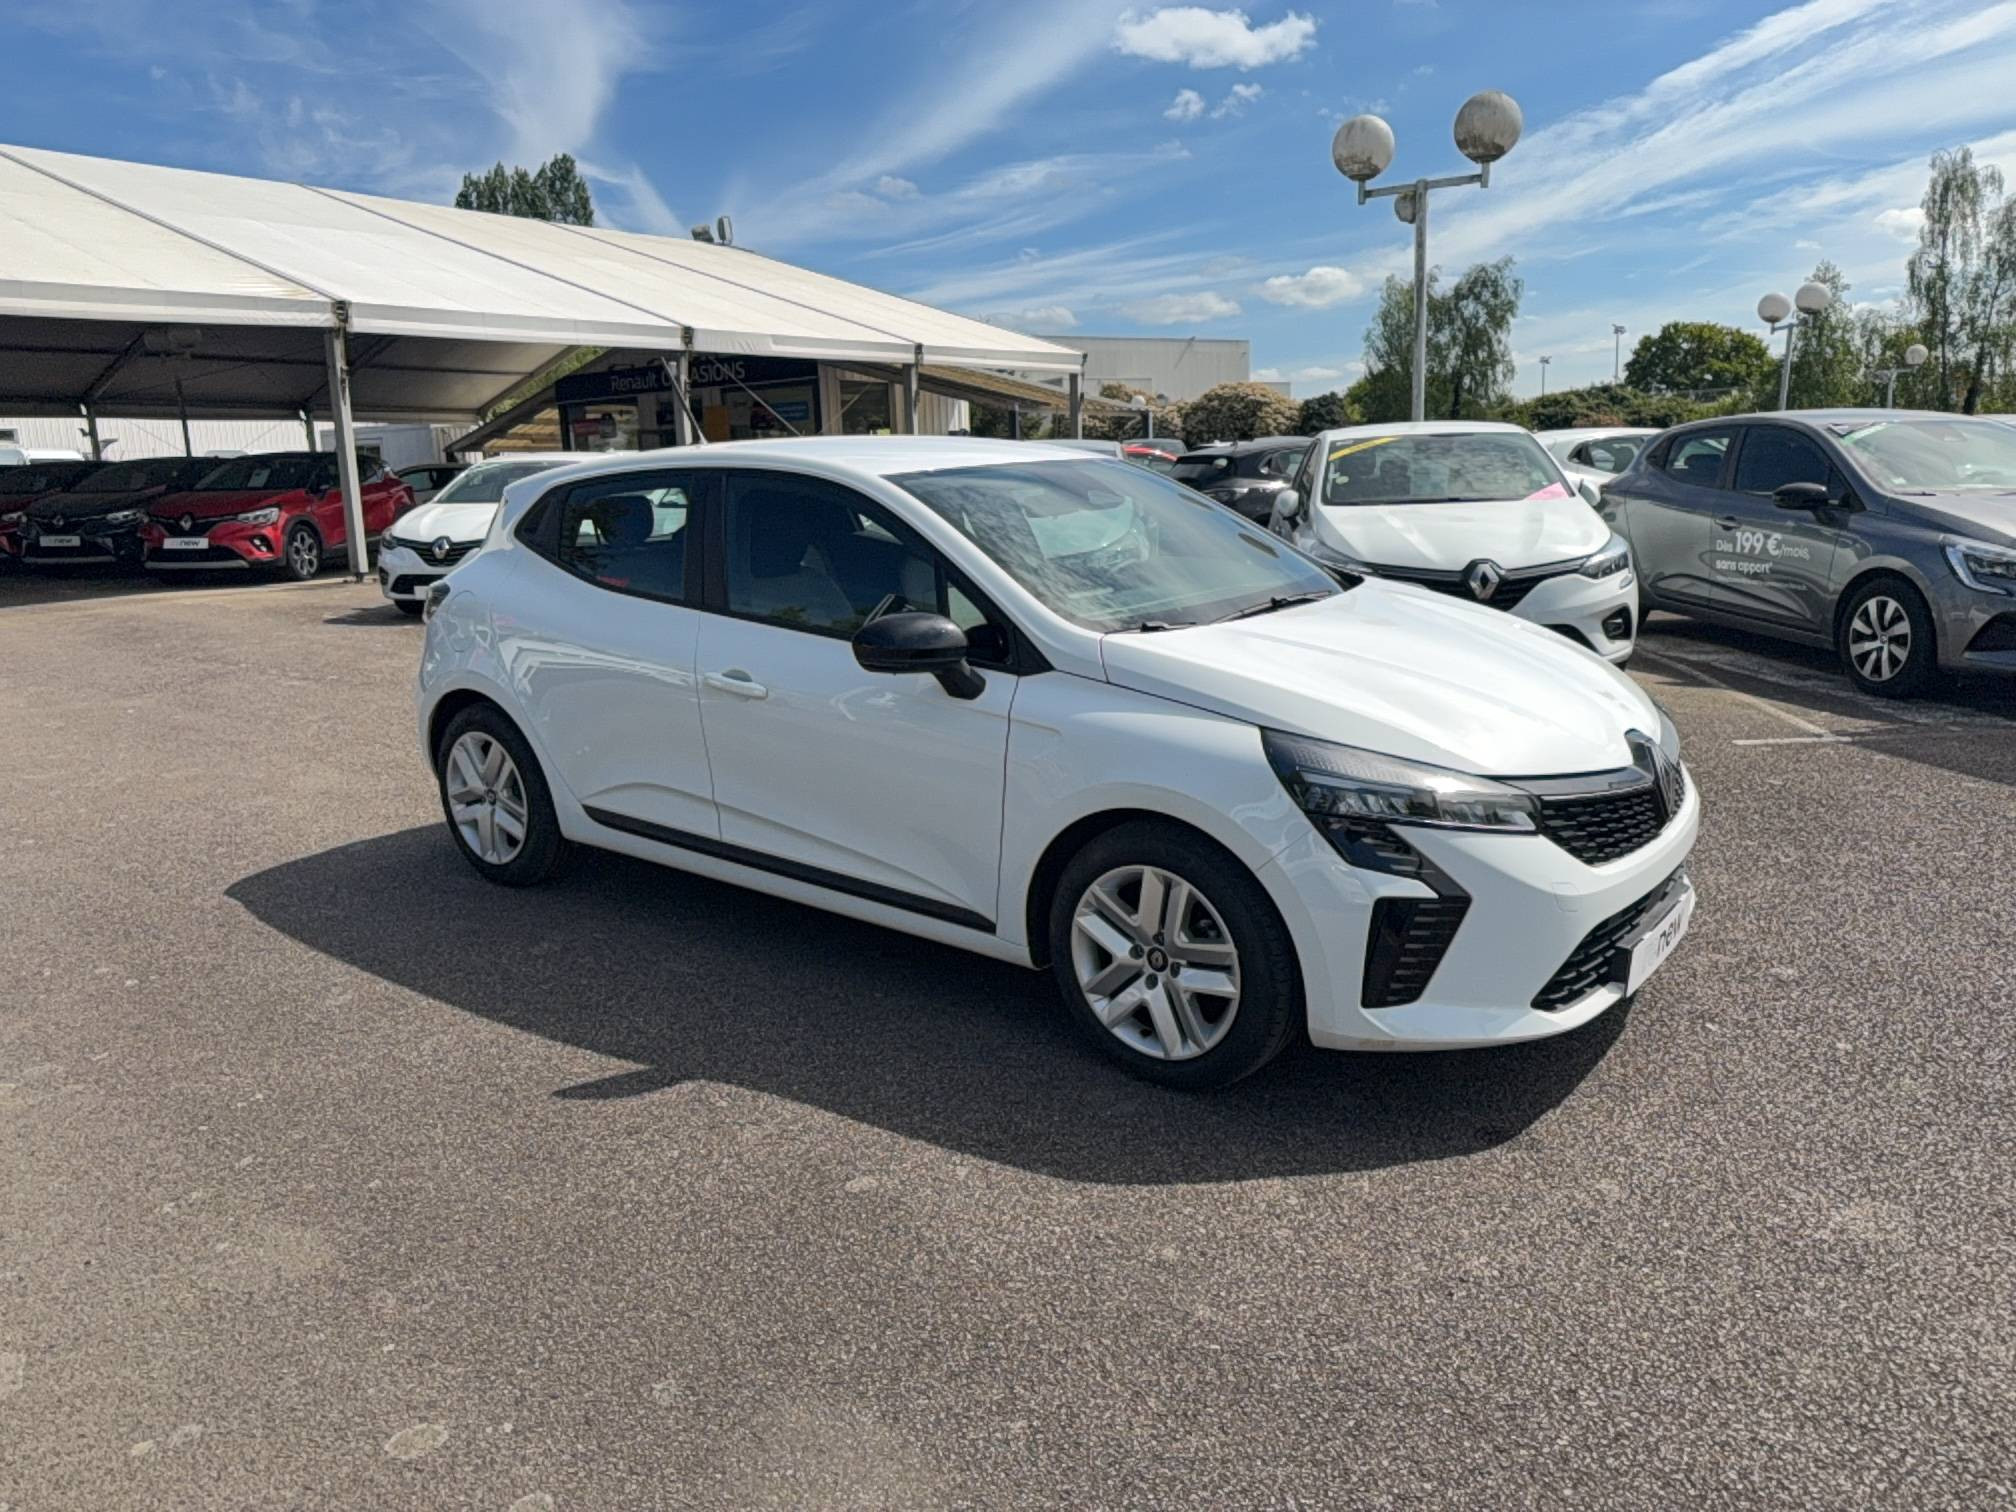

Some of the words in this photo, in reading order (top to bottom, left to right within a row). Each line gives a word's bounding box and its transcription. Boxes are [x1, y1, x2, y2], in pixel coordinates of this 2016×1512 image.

[610, 370, 658, 391] Renault
[661, 361, 745, 386] OASIONS
[1735, 531, 1764, 555] 199
[1715, 559, 1737, 571] sans
